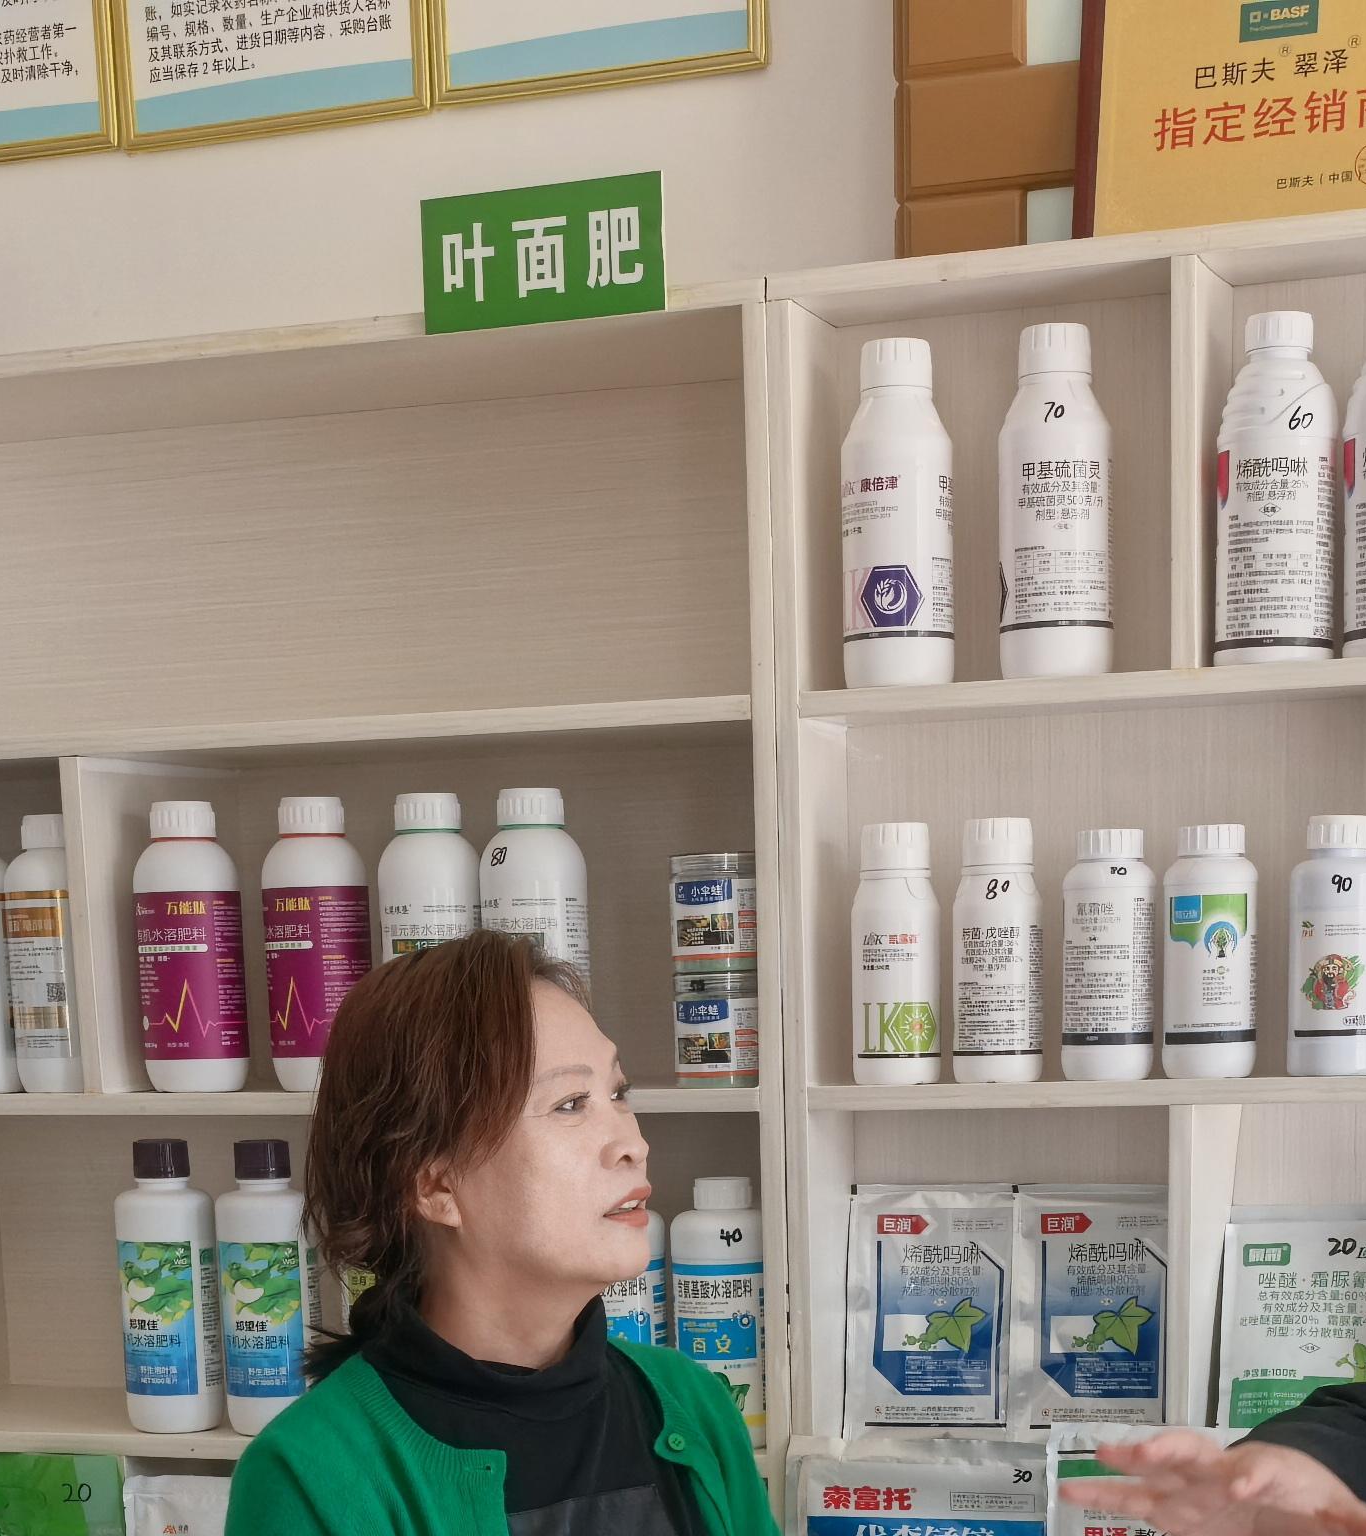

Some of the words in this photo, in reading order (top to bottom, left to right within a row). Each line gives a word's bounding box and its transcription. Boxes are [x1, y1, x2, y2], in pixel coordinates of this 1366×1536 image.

[1271, 5, 1310, 20] BASF
[1194, 57, 1276, 89] 巴斯夫
[1294, 49, 1349, 77] 翠泽
[442, 206, 643, 302] 叶面肥
[1043, 401, 1065, 423] 70
[1288, 406, 1314, 430] 60
[1021, 461, 1101, 481] 甲基硫菌灵
[985, 879, 1010, 900] 80
[1332, 874, 1352, 893] 90
[883, 1218, 912, 1233] 巨润
[1047, 1218, 1075, 1232] 巨润
[720, 1228, 742, 1247] 40
[1328, 1237, 1356, 1256] 20
[902, 1243, 982, 1264] 烯酰吗啉
[1068, 1242, 1147, 1264] 烯酰吗啉
[1013, 1469, 1033, 1483] 30
[62, 1483, 92, 1503] 20
[823, 1485, 912, 1511] 索富托
